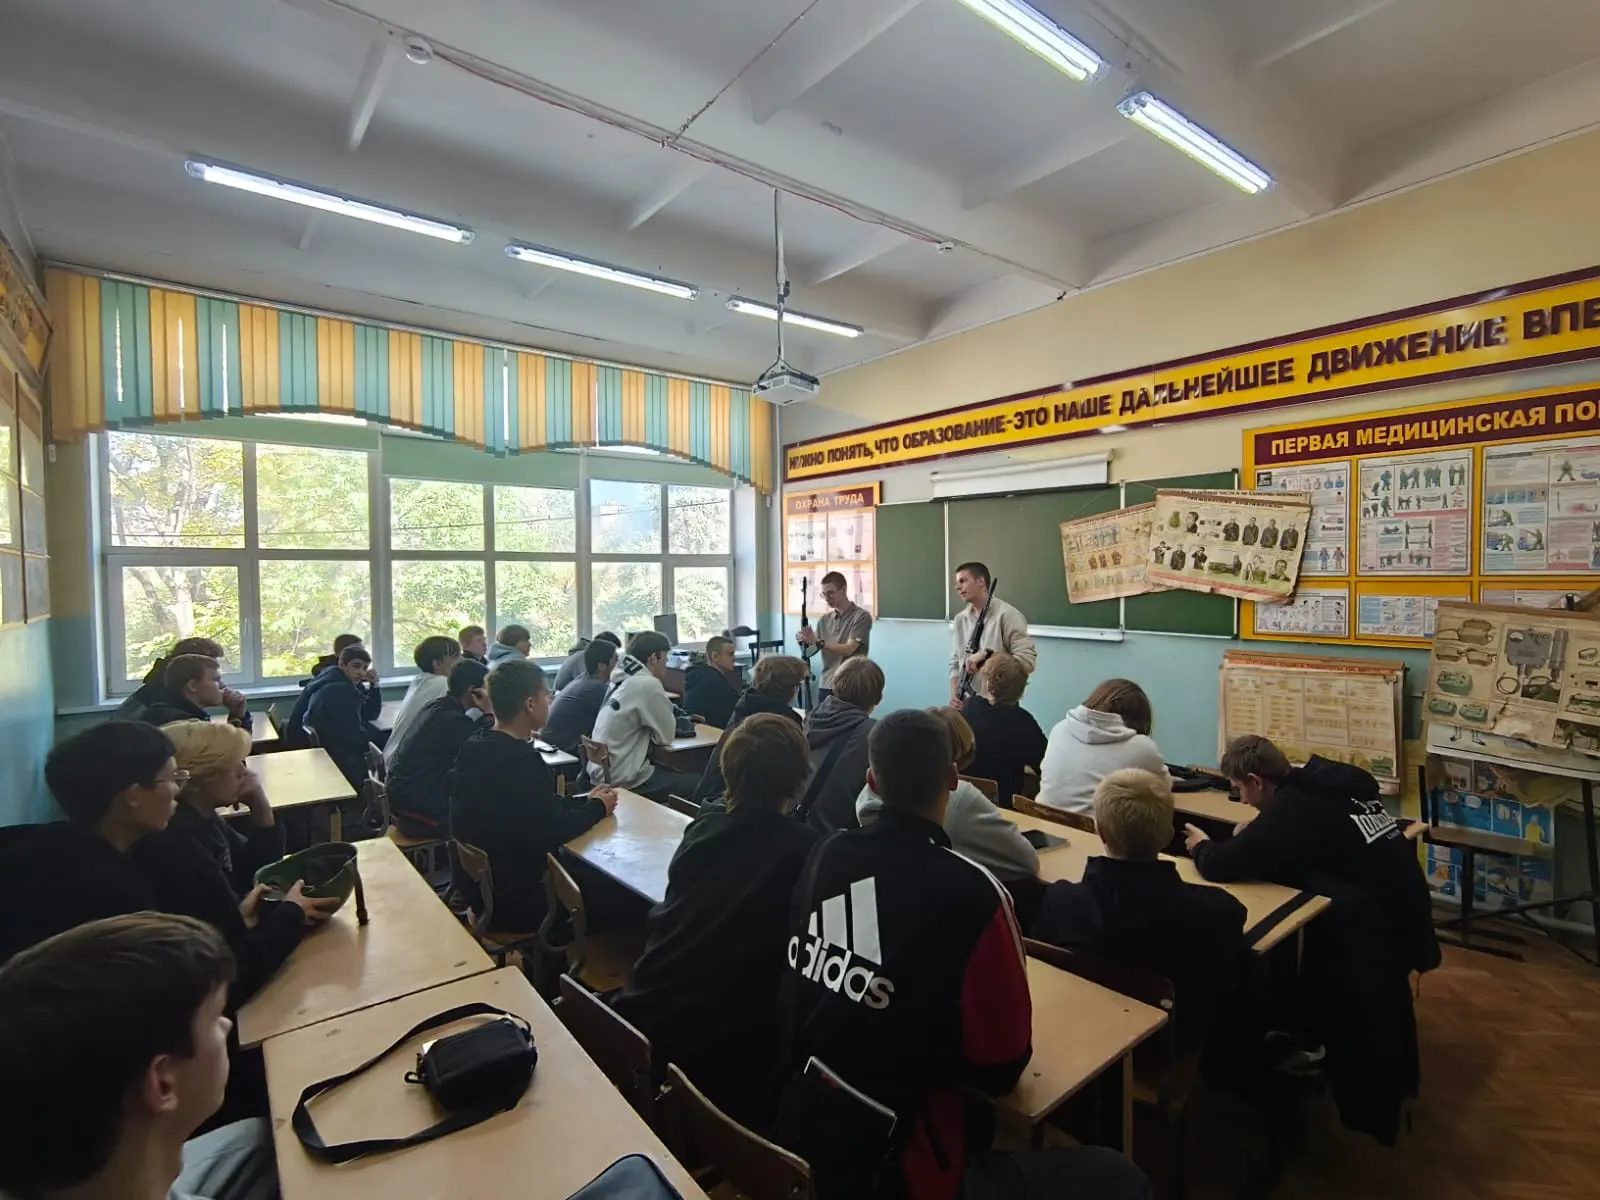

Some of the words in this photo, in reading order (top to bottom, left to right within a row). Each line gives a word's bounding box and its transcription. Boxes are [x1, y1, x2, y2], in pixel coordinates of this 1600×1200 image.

[827, 442, 874, 463] ПОНЯТЬ,
[874, 436, 899, 455] ЧТО
[1054, 394, 1112, 424] НАШЕ
[1119, 357, 1295, 417] ДАЛЬНЕЙШЕЕ
[1307, 316, 1508, 383] ДВИЖЕНИЕ
[1271, 428, 1350, 456] ПЕРВАЯ
[1356, 406, 1547, 447] МЕДИЦИНСКАЯ
[1554, 400, 1600, 424] ПО
[795, 496, 831, 510] ОХРАНА
[834, 492, 865, 506] ТРУДА
[787, 935, 895, 1010] adidas
